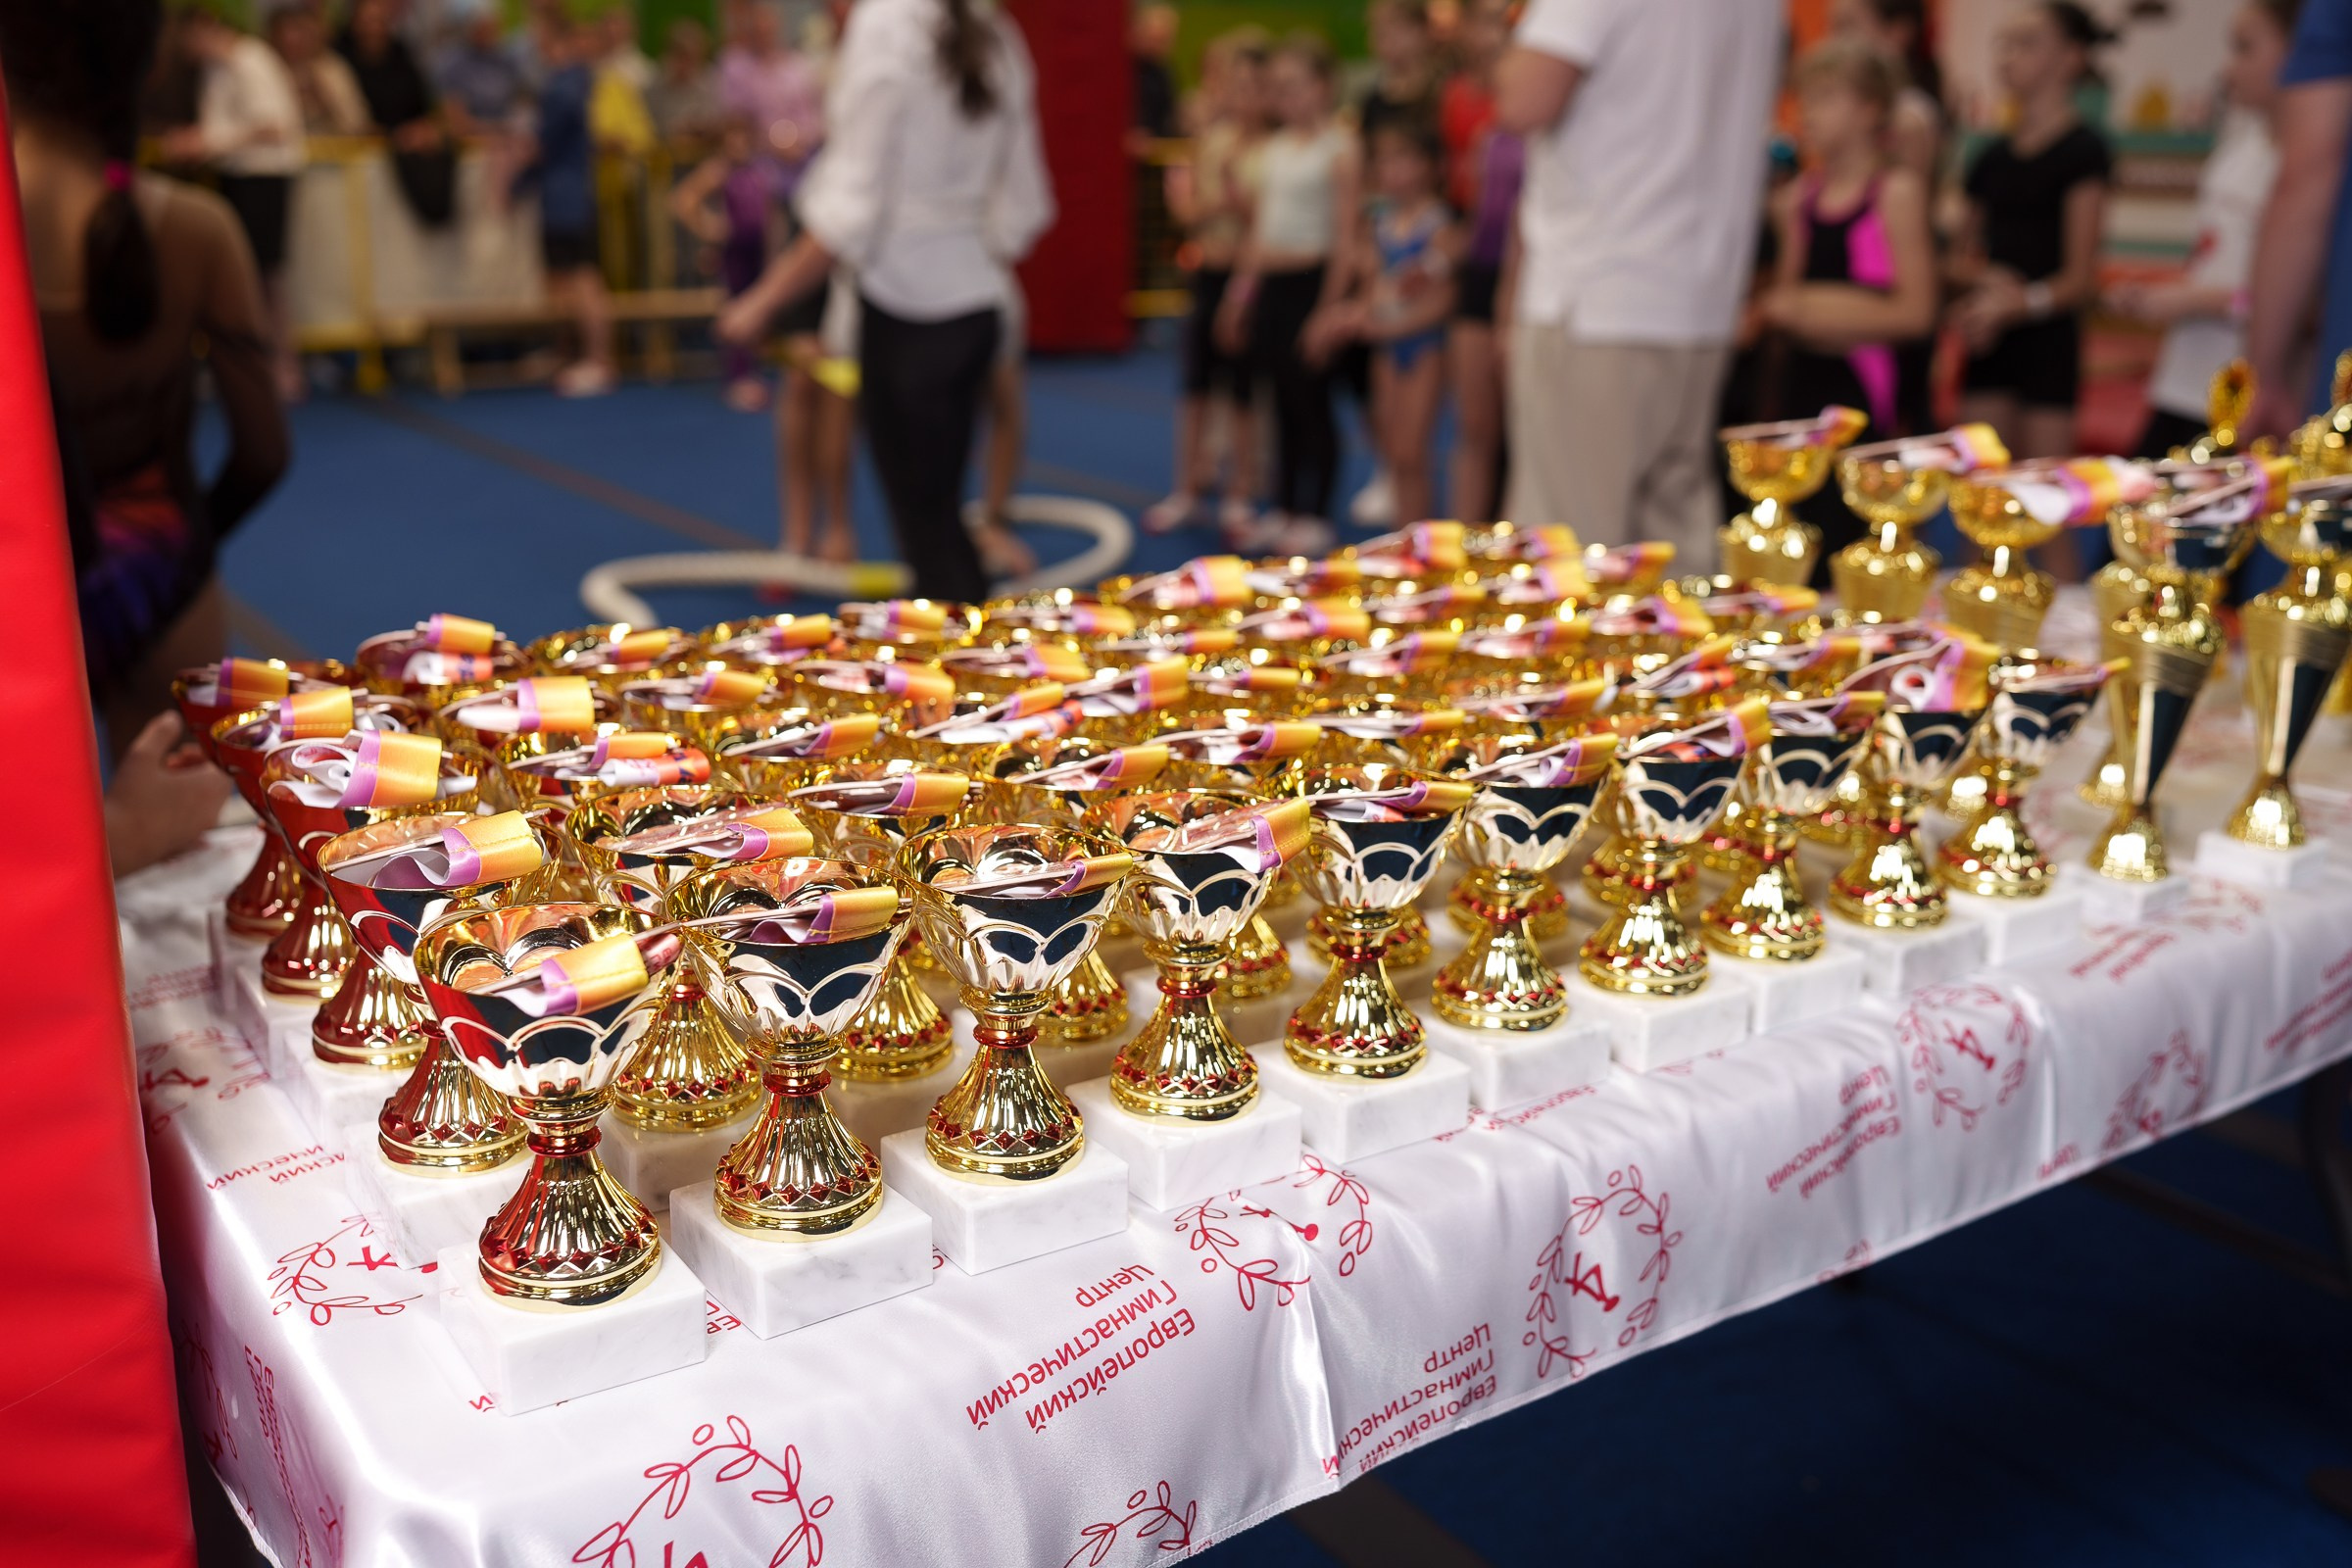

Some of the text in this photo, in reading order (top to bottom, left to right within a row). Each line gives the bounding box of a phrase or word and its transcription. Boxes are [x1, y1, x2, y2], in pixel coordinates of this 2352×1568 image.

[1075, 1264, 1154, 1309] Центр
[965, 1279, 1178, 1432] Гимнастический
[1024, 1307, 1196, 1435] Европейский
[1423, 1322, 1492, 1374] Центр
